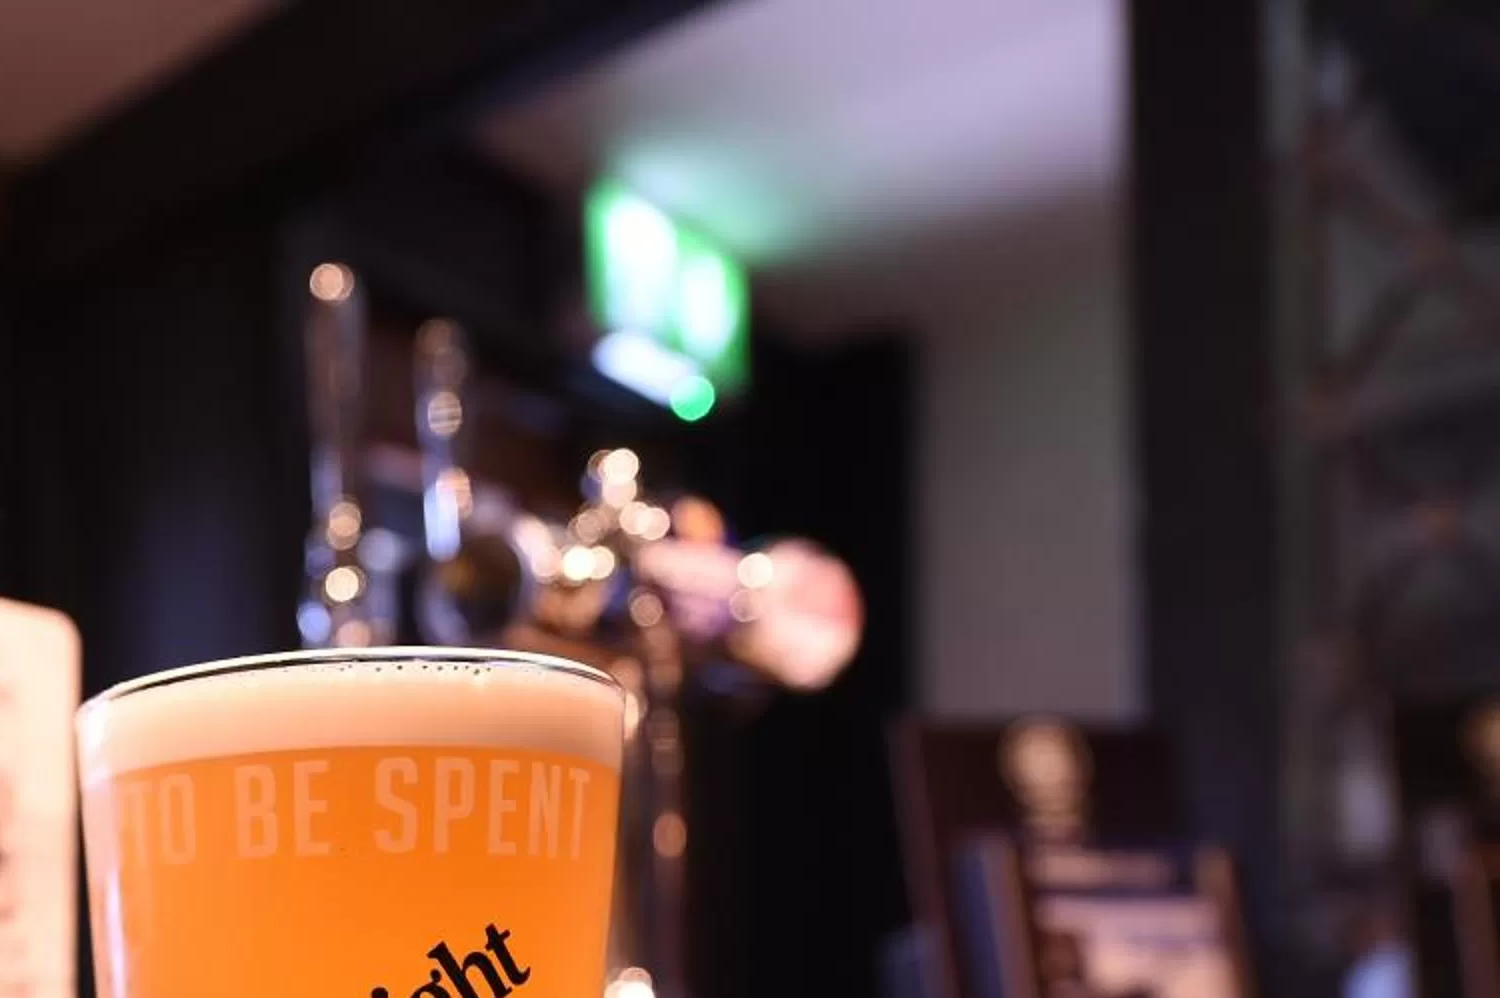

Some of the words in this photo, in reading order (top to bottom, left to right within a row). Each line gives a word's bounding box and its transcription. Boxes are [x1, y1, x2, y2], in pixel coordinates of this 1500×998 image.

[120, 773, 197, 868] TO
[234, 761, 332, 859] BE
[373, 756, 591, 861] SPENT
